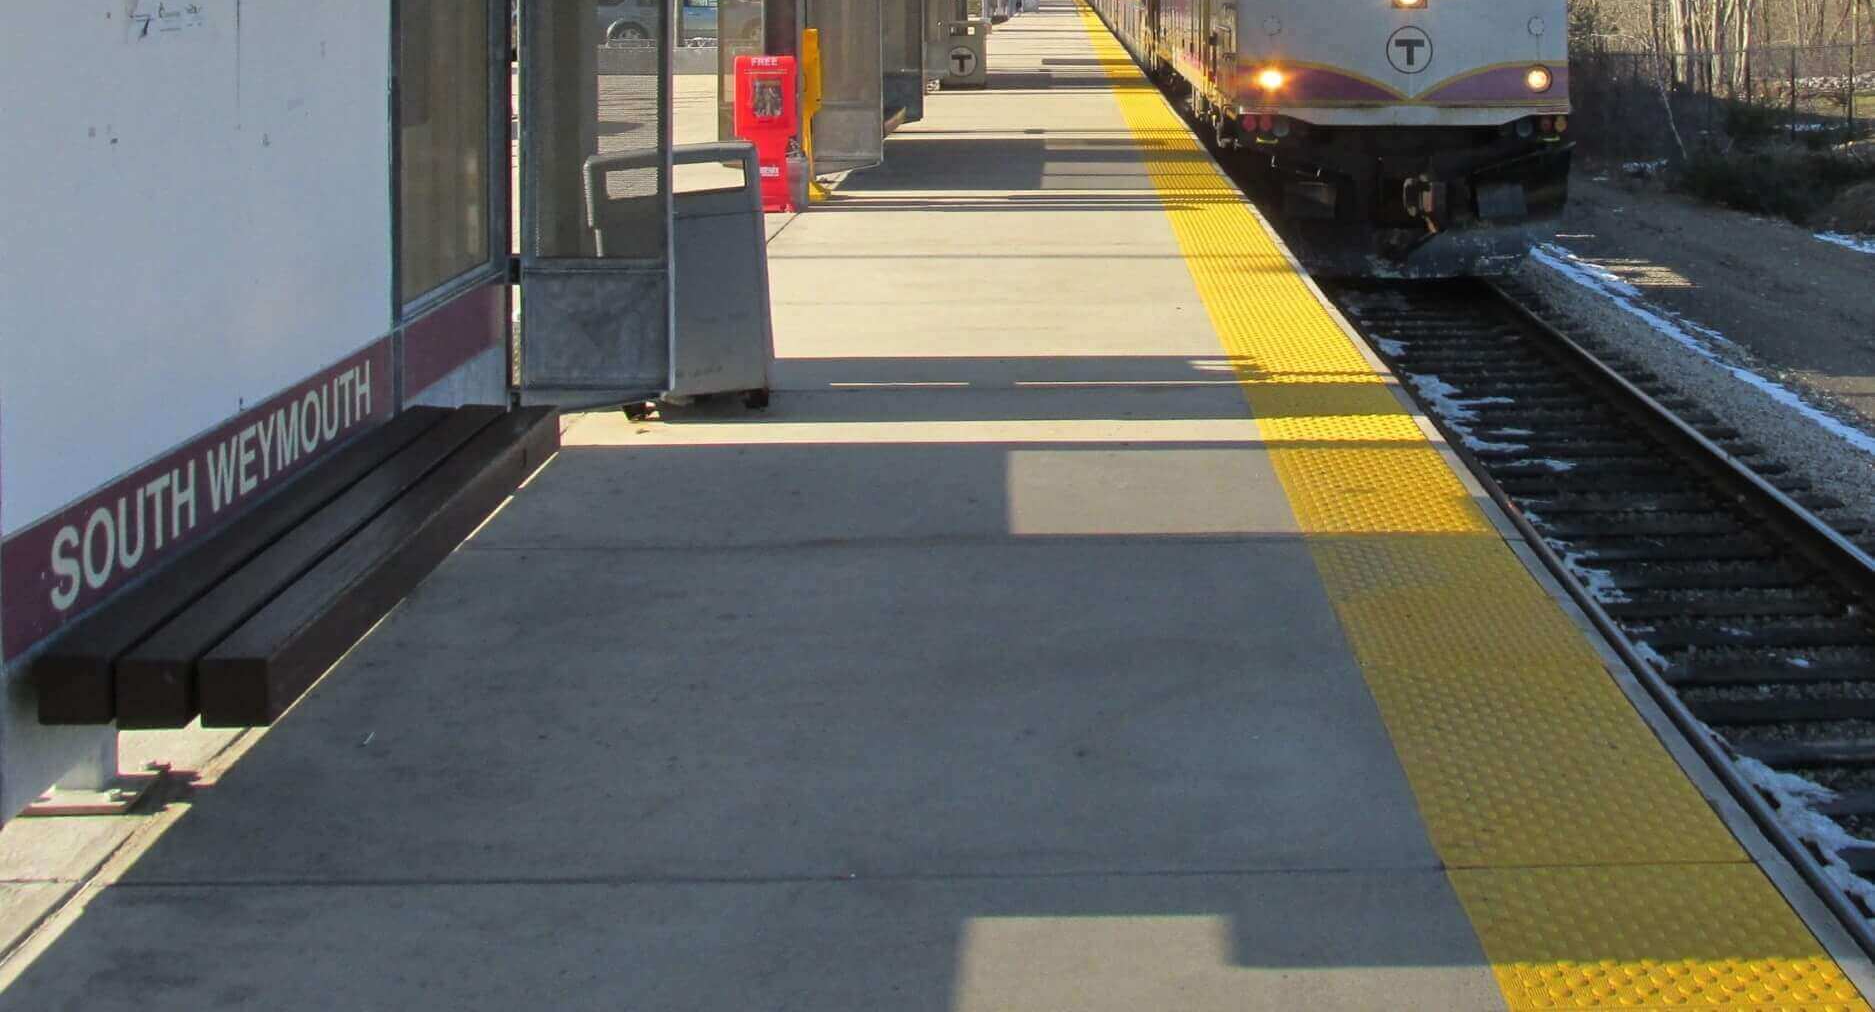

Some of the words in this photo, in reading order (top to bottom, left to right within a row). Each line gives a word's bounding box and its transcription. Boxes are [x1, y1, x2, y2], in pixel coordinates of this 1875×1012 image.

[751, 56, 778, 66] FREE
[50, 459, 196, 611] SOUTH
[206, 359, 373, 512] WEYMOUTH
